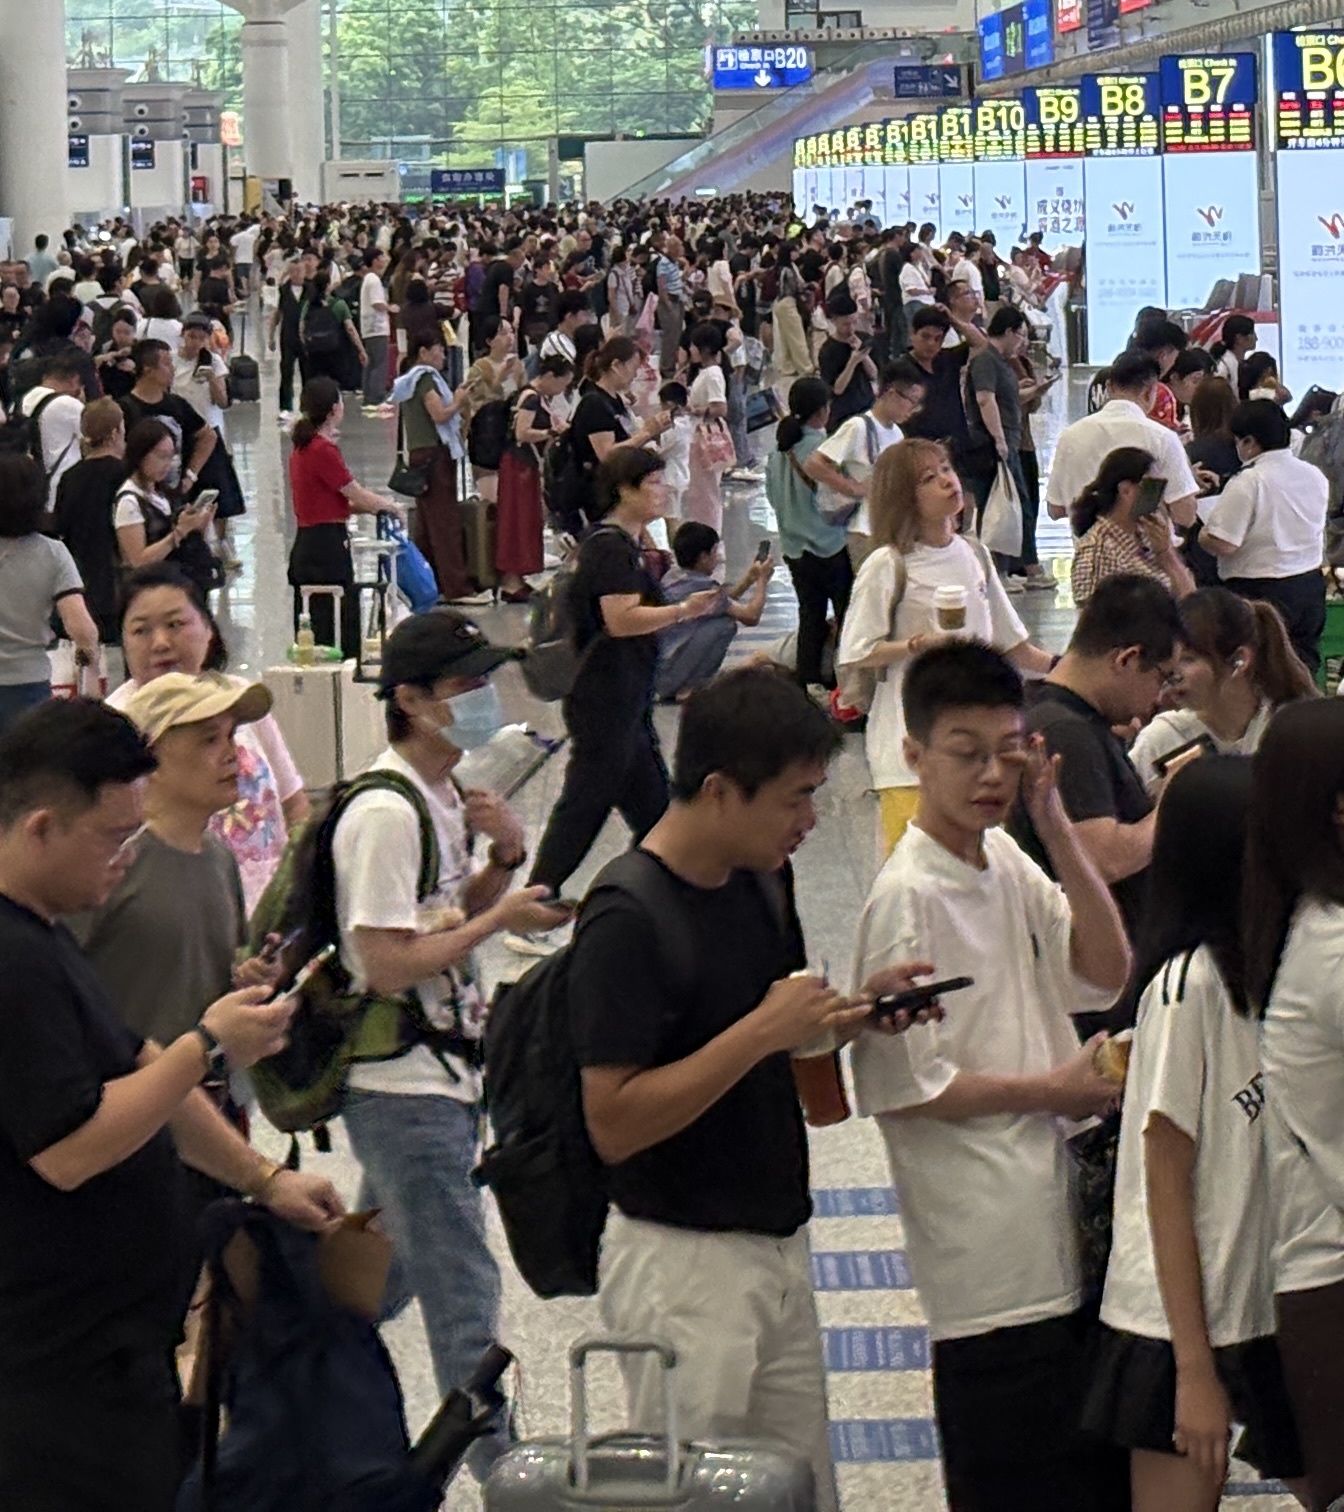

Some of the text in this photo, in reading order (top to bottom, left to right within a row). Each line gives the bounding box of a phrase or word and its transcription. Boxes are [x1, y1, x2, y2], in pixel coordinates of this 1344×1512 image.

[775, 47, 806, 69] B20
[1184, 68, 1235, 105] B7
[1040, 96, 1078, 124] B9
[1101, 84, 1145, 116] B8
[911, 120, 937, 140] B1
[942, 114, 971, 137] B1
[977, 106, 1025, 131] B10
